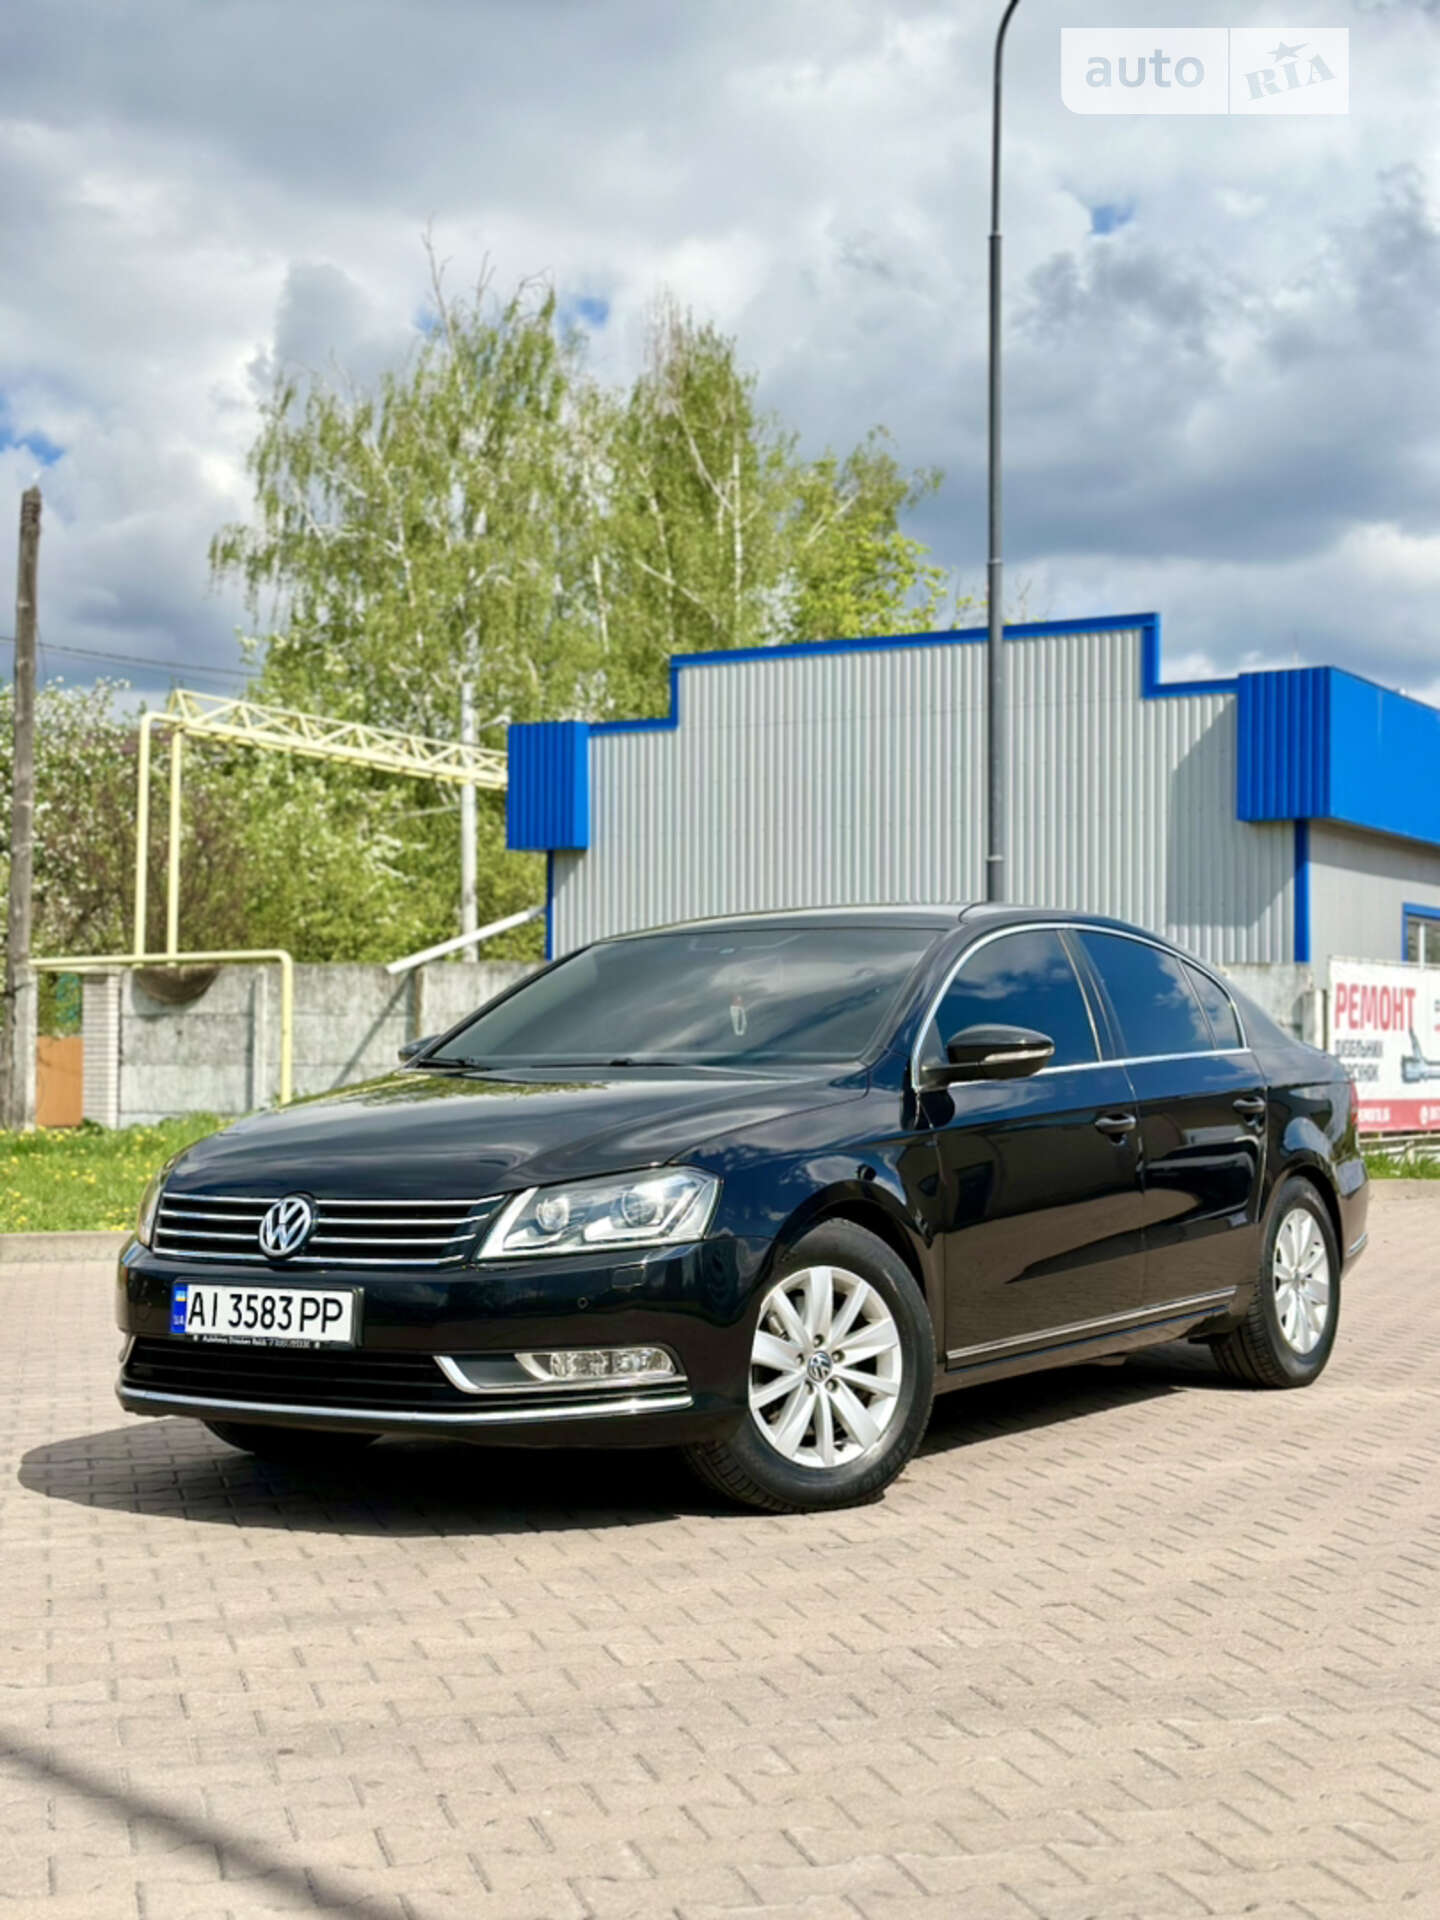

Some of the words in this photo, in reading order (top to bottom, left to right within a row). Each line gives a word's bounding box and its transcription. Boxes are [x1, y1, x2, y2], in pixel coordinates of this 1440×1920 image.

[1335, 982, 1416, 1031] РЕМОНТ
[188, 1292, 218, 1327] AI
[228, 1293, 294, 1331] 3583
[299, 1297, 343, 1334] PP
